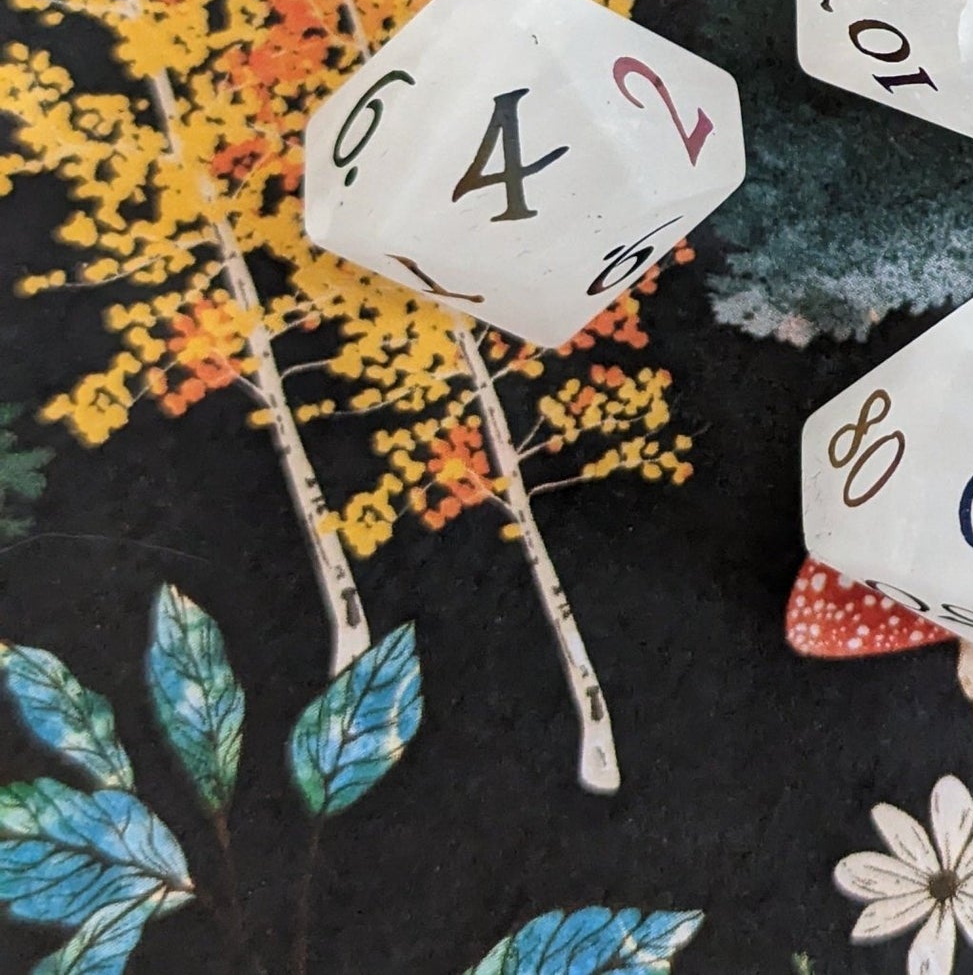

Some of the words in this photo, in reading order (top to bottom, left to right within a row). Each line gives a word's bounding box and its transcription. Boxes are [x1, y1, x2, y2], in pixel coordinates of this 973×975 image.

[613, 56, 714, 167] 2
[848, 19, 939, 94] 10
[452, 88, 569, 222] 4
[828, 389, 906, 507] 80
